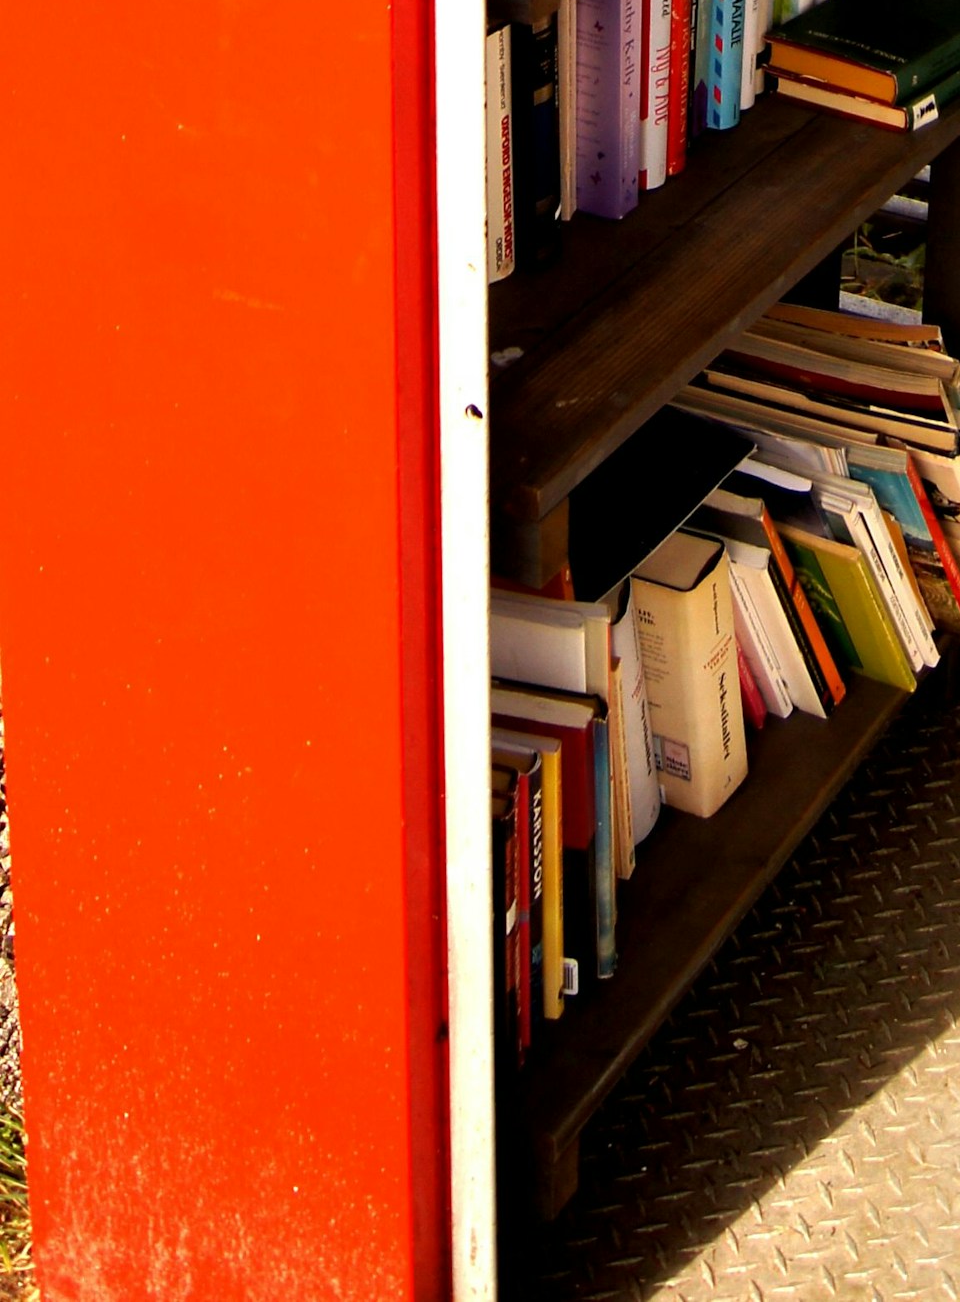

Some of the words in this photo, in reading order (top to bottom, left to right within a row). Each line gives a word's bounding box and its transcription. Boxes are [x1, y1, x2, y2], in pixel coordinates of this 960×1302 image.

[621, 38, 635, 87] Kelly
[502, 114, 511, 166] OXFORD
[503, 166, 514, 263] ENGELSK-NORS
[533, 787, 543, 900] KARLSSON
